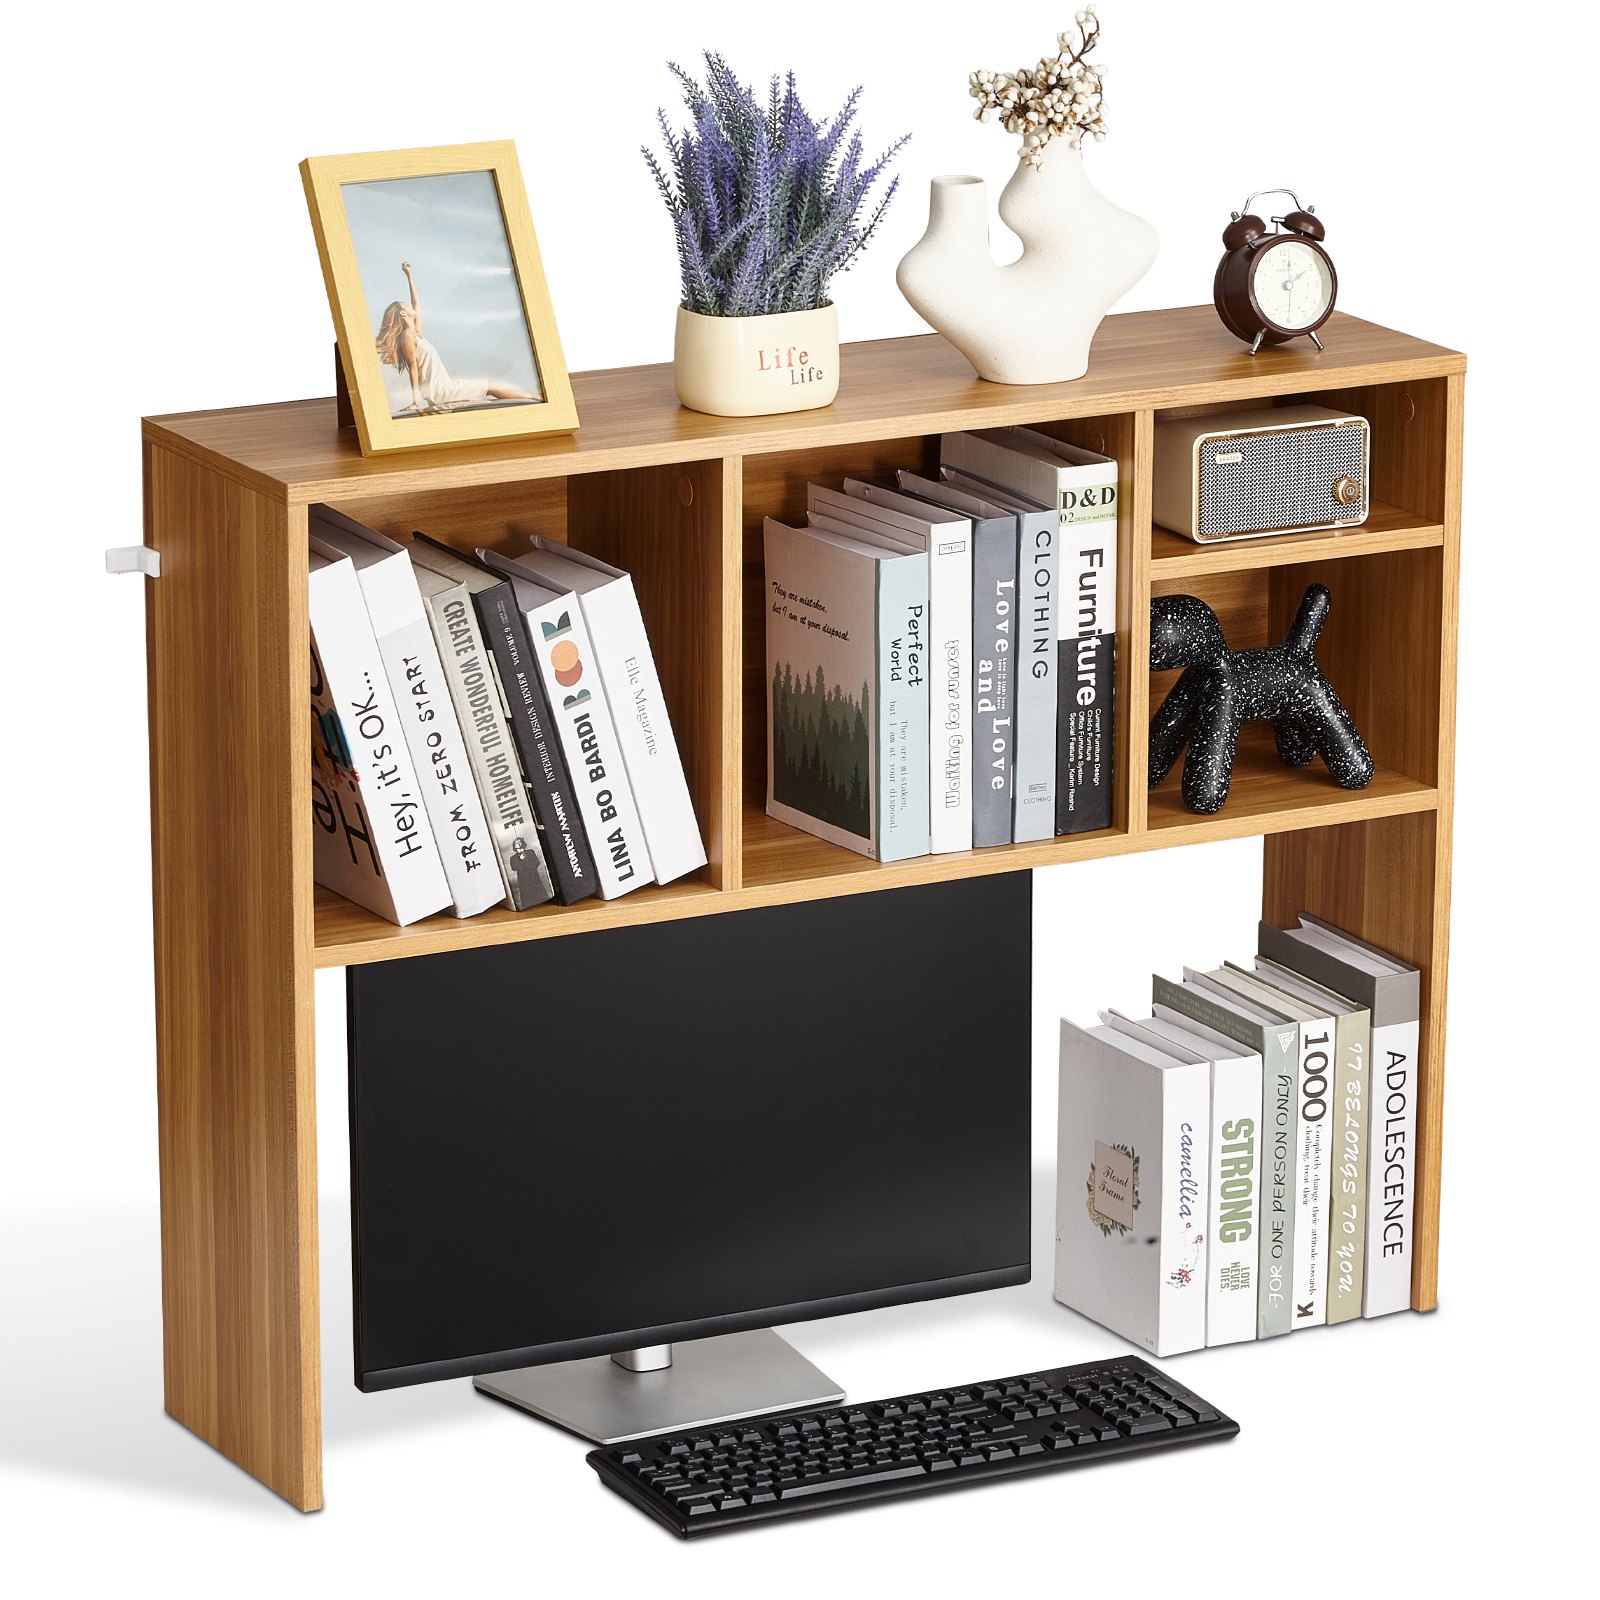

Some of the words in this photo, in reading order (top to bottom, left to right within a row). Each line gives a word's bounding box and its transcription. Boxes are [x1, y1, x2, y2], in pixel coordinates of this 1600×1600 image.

[758, 346, 809, 371] Life
[790, 366, 824, 386] Life
[772, 581, 787, 600] They
[1032, 530, 1052, 679] CLOTHING
[443, 600, 476, 657] CREATE
[772, 601, 782, 615] but
[788, 612, 798, 622] am
[799, 616, 807, 625] at
[807, 619, 821, 632] your
[995, 578, 1015, 653] Love
[1076, 548, 1104, 706] Furniture
[505, 633, 520, 666] VOLUME
[890, 637, 902, 682] World
[907, 604, 923, 687] Perfect
[945, 639, 960, 699] sunset
[402, 656, 435, 722] START
[516, 672, 533, 705] REVIEW
[977, 659, 997, 714] and
[351, 671, 384, 740] OK...
[459, 655, 502, 753] WONDERFUL
[624, 656, 639, 686] Elle
[633, 687, 658, 756] Magazine
[889, 700, 898, 717] but
[945, 702, 960, 730] for
[1094, 708, 1102, 733] Current
[526, 706, 544, 740] DESIGN
[889, 731, 895, 743] am
[900, 719, 909, 741] They
[1069, 712, 1077, 736] Special
[537, 740, 556, 784] INTERIOR
[573, 712, 607, 784] BARDI
[889, 747, 897, 757] at
[991, 716, 1011, 790] Love
[1069, 737, 1077, 763] Feature
[1077, 730, 1085, 760] Furniture
[1085, 732, 1093, 761] Furniture
[1094, 733, 1102, 763] Furniture
[372, 744, 401, 790] it's
[426, 732, 458, 795] ZERO
[945, 734, 964, 809] Waiting
[1076, 760, 1084, 785] System
[1092, 763, 1101, 787] Design
[485, 752, 525, 830] HOMELIFE
[596, 789, 618, 823] BO
[1024, 795, 1052, 805] CLOTHING
[1068, 788, 1076, 811] Rashid
[390, 793, 422, 858] Hey,
[550, 791, 570, 831] MARTIN
[449, 803, 481, 873] FROM
[562, 831, 584, 878] ANDREW
[606, 826, 635, 882] LINA
[1302, 1031, 1329, 1122] 1000
[1312, 1124, 1323, 1170] Completely
[1340, 1079, 1361, 1194] BELONGS
[1178, 1122, 1199, 1219] camellia
[1383, 1050, 1407, 1258] ADOLESCENCE
[1102, 1165, 1129, 1187] Floral
[1219, 1117, 1255, 1244] STRONG
[1272, 1131, 1288, 1212] PERSON
[1311, 1174, 1321, 1203] change
[1098, 1180, 1126, 1202] Frame
[1302, 1187, 1310, 1207] their
[1312, 1206, 1320, 1226] their
[1271, 1220, 1284, 1259] ONE
[1311, 1228, 1319, 1261] attitude
[1219, 1267, 1230, 1292] DIES.
[1230, 1261, 1241, 1291] NEVER
[1240, 1266, 1250, 1289] LOVE
[1309, 1263, 1317, 1296] towards
